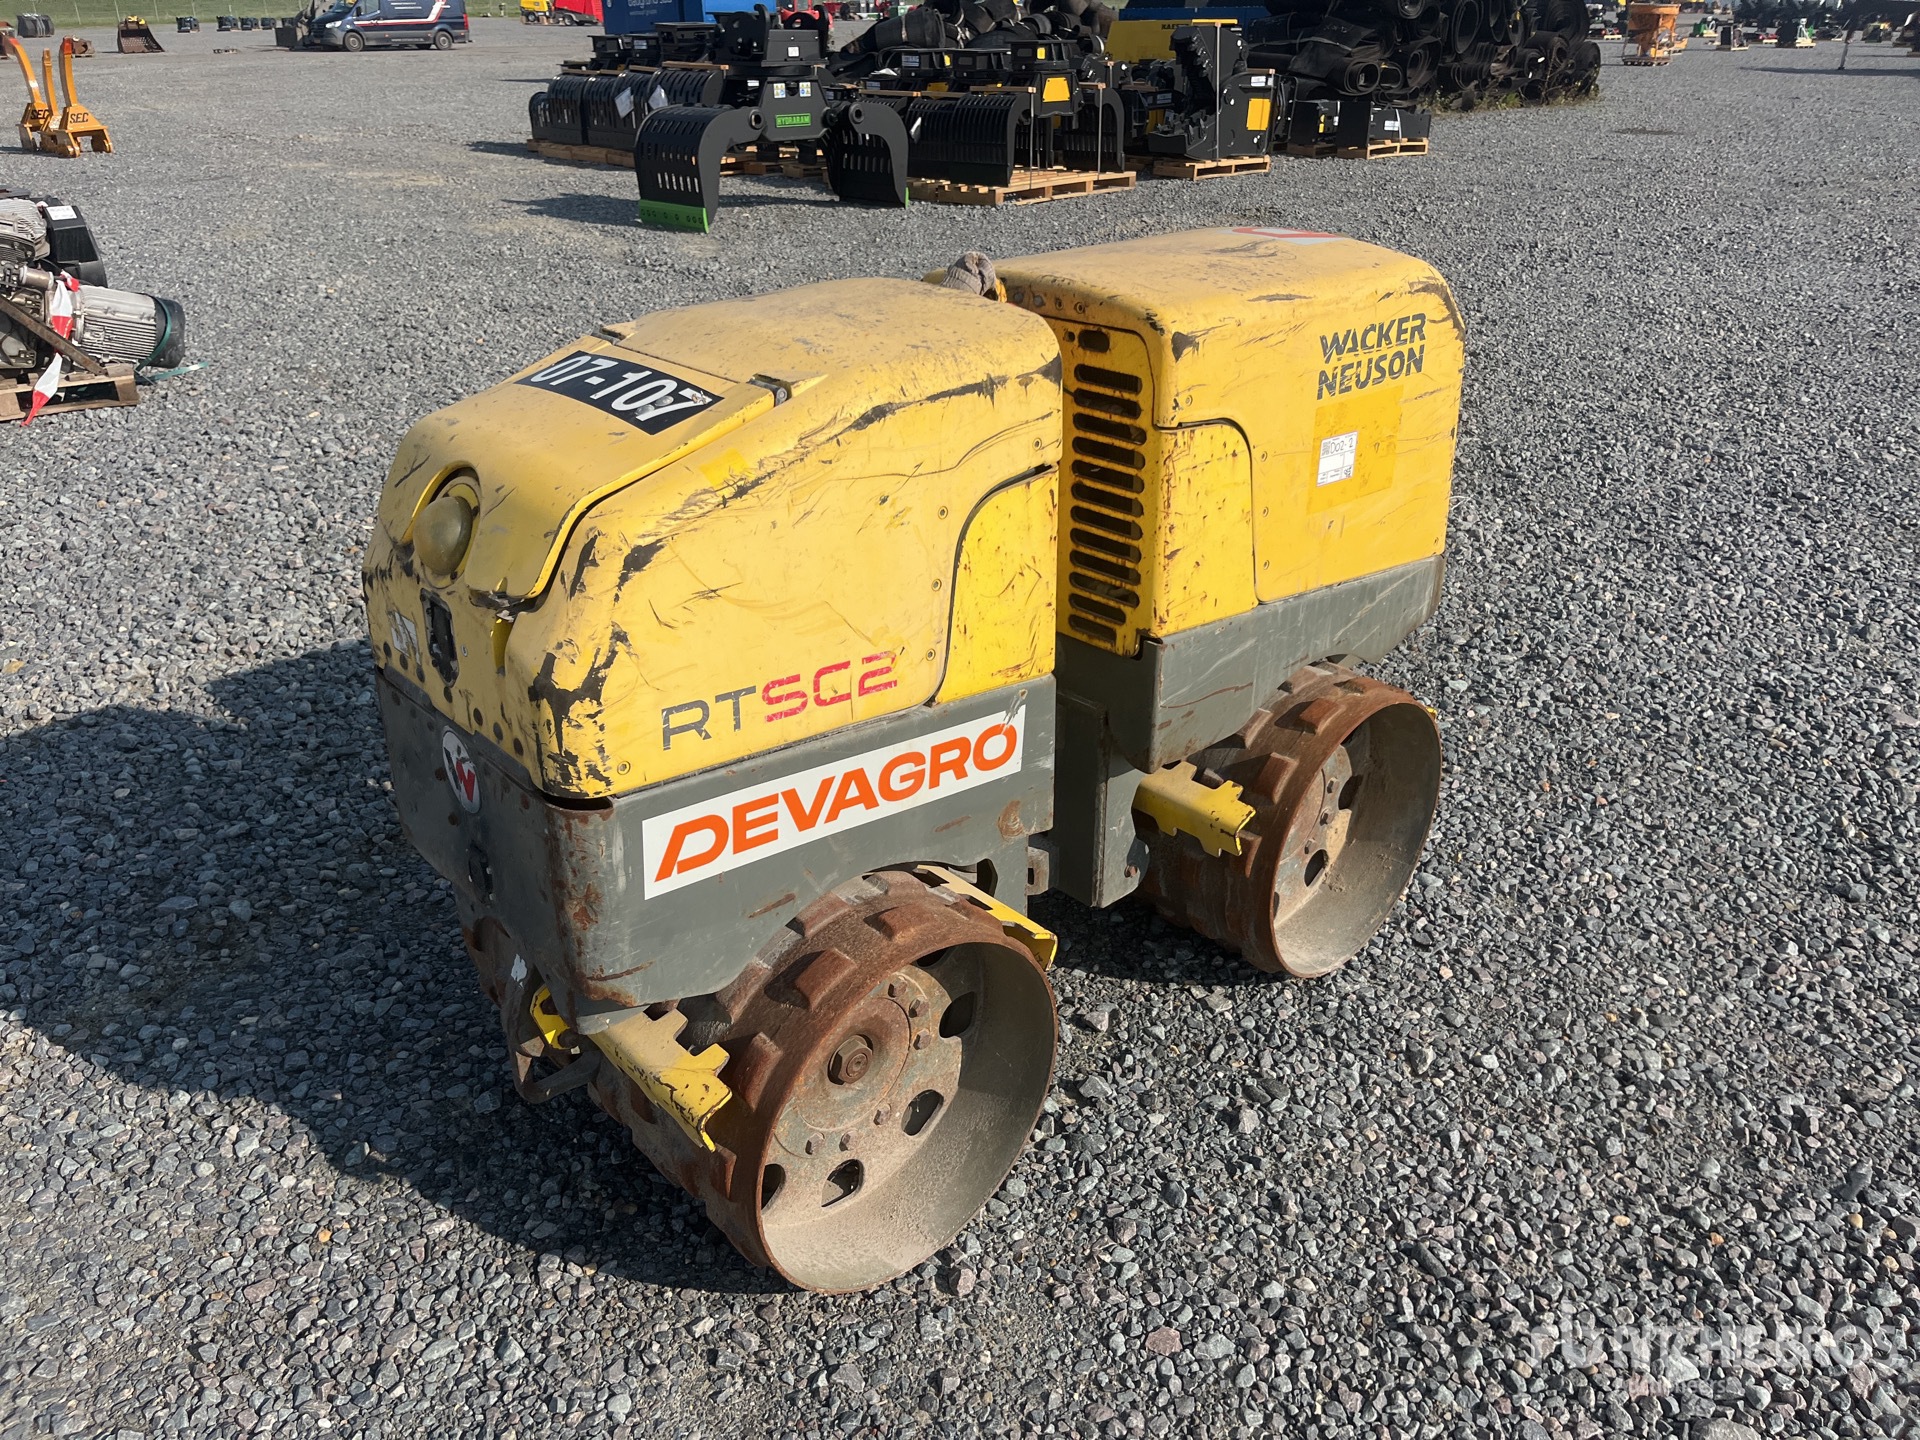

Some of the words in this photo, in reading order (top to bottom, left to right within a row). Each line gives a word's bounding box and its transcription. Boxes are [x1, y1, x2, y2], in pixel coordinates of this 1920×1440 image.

[70, 112, 89, 123] SEC
[1319, 313, 1426, 364] WACKER
[530, 355, 713, 422] 07-107
[1316, 344, 1425, 400] NEUSON
[654, 723, 1018, 883] DEVAGRO
